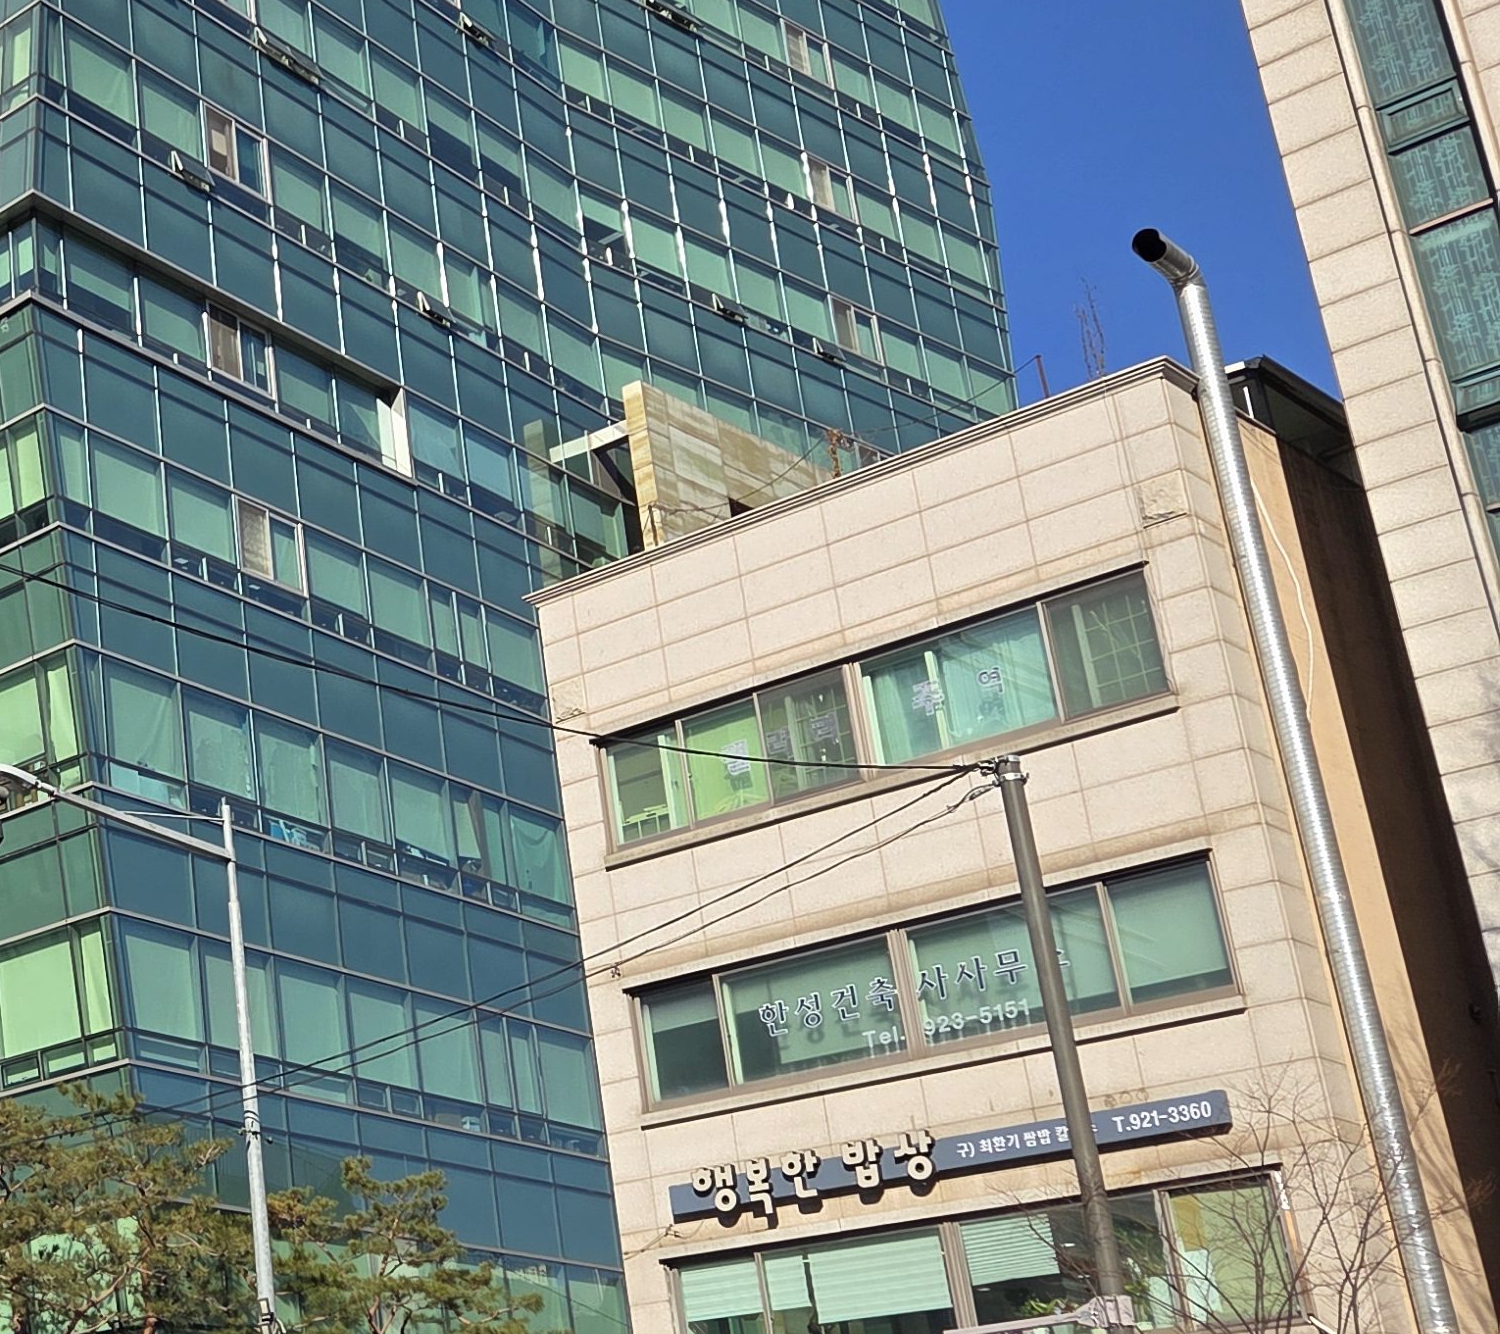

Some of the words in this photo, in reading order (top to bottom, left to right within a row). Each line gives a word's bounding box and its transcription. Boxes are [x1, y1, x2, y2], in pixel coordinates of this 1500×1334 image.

[861, 1023, 906, 1049] Tel.
[1111, 1100, 1213, 1134] T.921-3360
[956, 1142, 976, 1159] 구)
[691, 1149, 819, 1215] 행복한
[841, 1129, 933, 1189] 밥상
